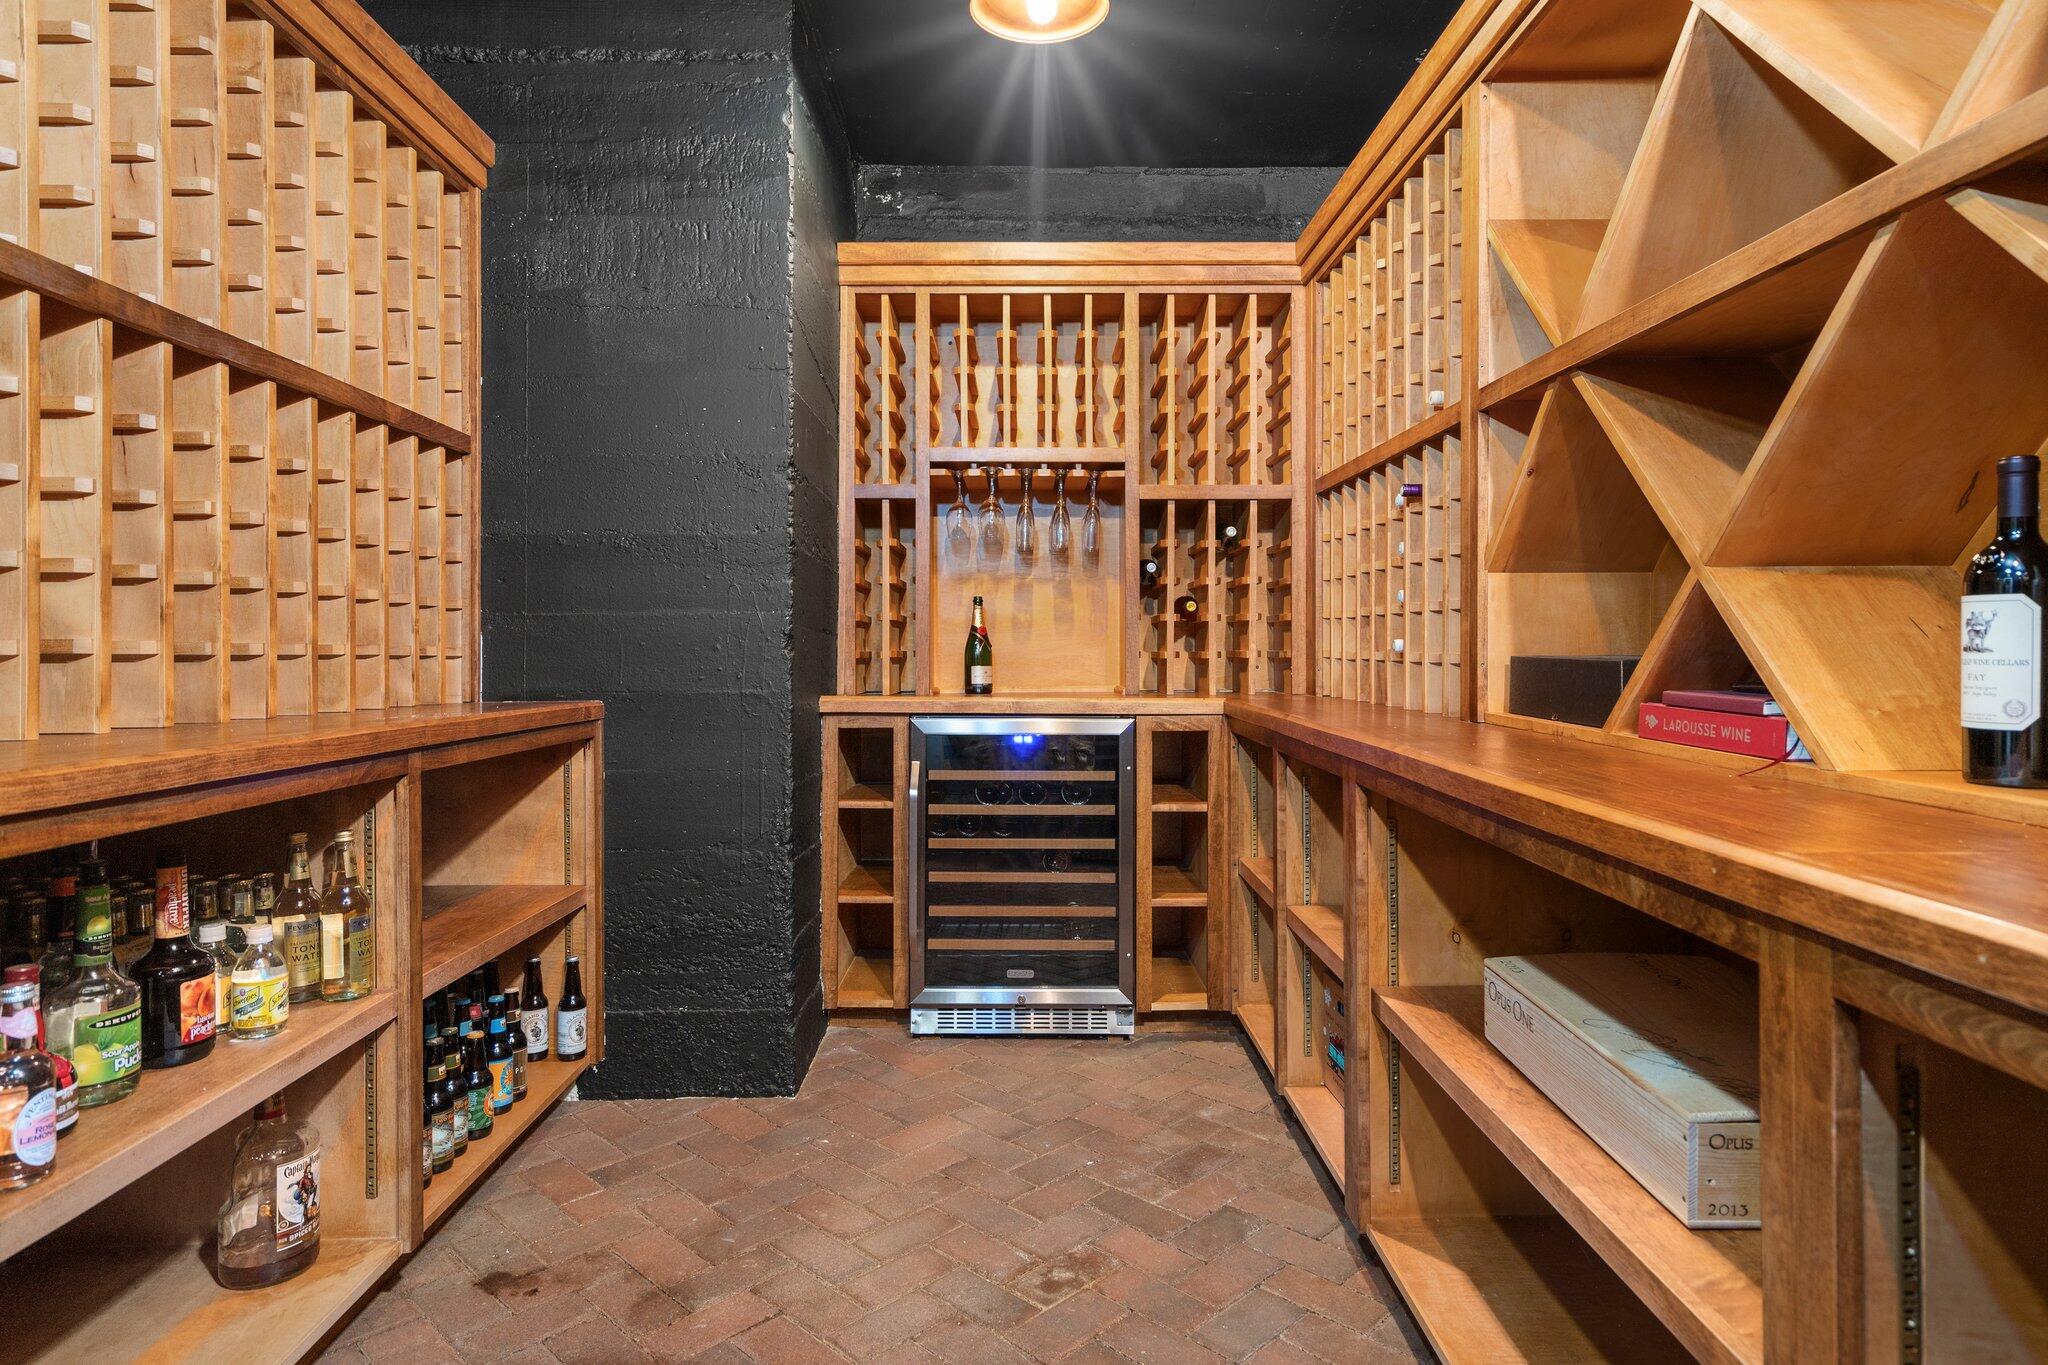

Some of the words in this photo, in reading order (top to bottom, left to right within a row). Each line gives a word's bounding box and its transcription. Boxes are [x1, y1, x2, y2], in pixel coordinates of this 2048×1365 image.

[1992, 658, 2031, 666] CELLARS
[1967, 673, 1986, 681] FAY
[1662, 718, 1717, 738] LAROUSSE
[1720, 725, 1751, 743] WINE
[291, 951, 320, 963] WATE
[1512, 1000, 1535, 1034] ONE
[102, 1049, 124, 1059] Sour
[1709, 1133, 1754, 1150] OPUS
[1708, 1204, 1749, 1217] 2013
